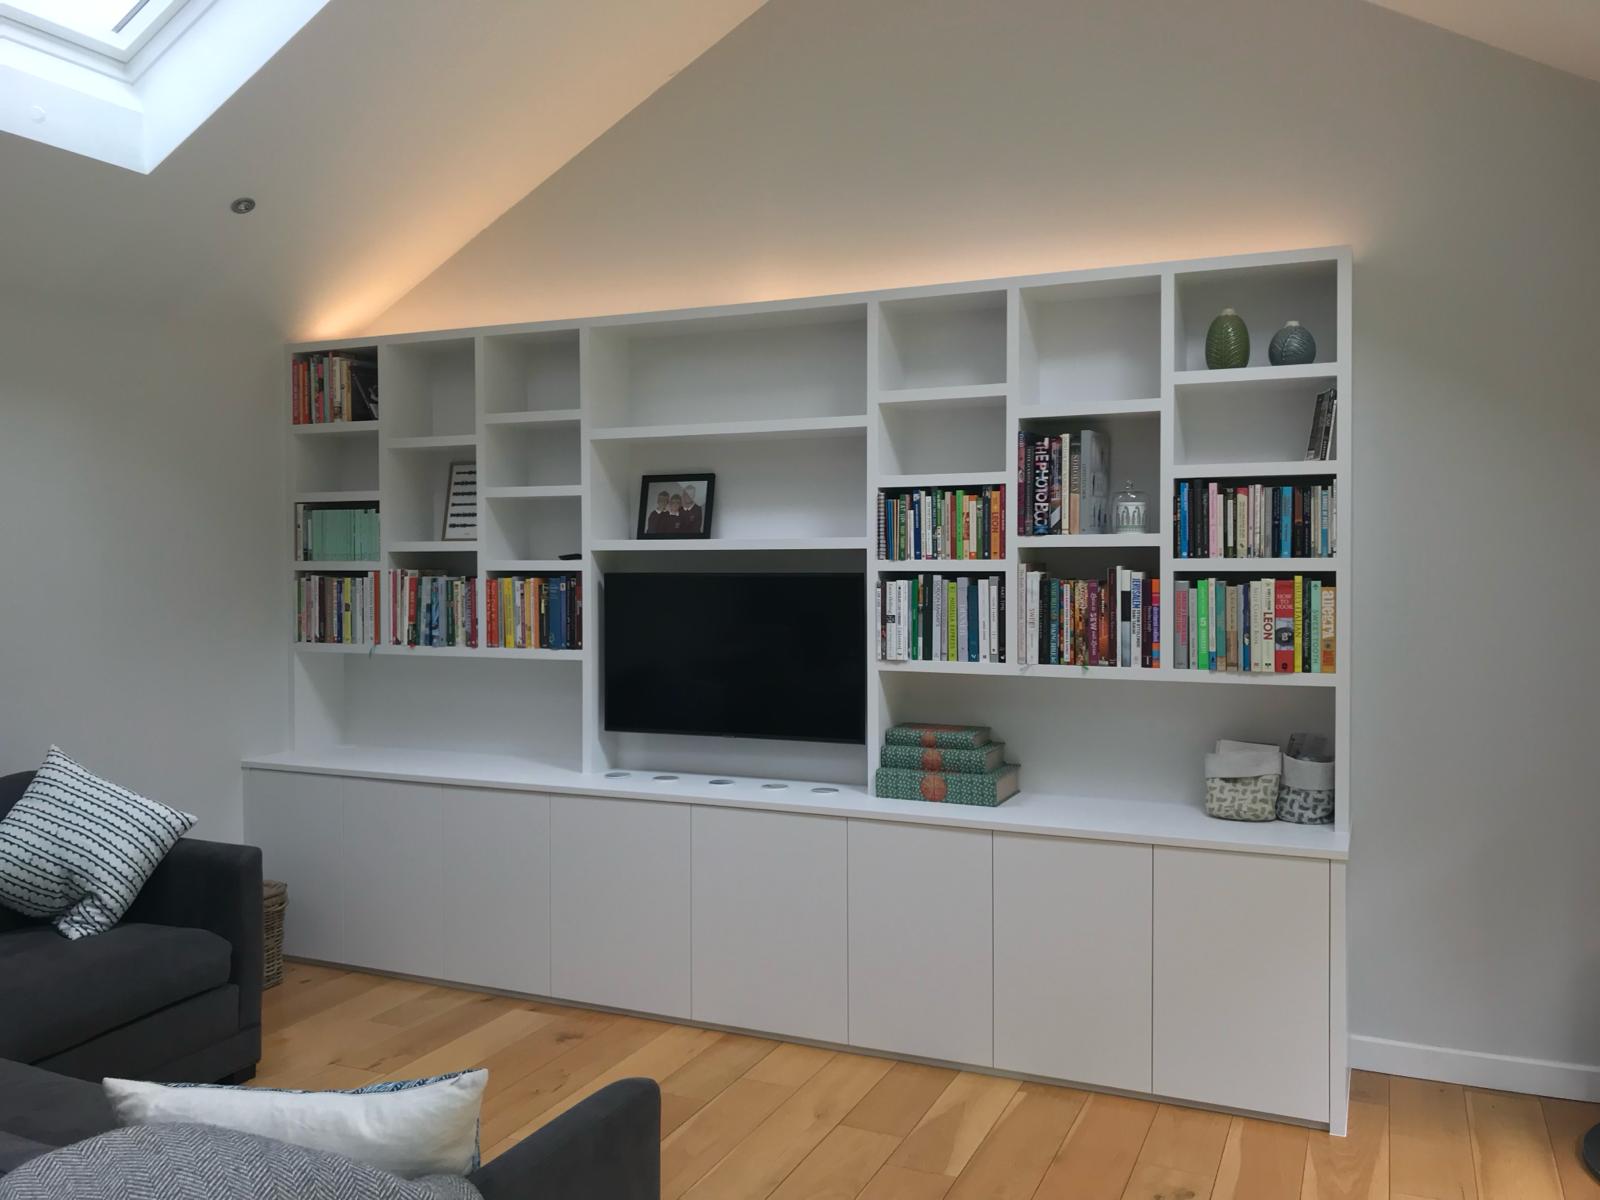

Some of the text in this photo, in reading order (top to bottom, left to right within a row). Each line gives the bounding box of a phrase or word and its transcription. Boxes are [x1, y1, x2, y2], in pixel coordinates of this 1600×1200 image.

[991, 511, 999, 533] LEON
[1132, 577, 1141, 609] JERUSALEM
[1263, 611, 1273, 640] LEON
